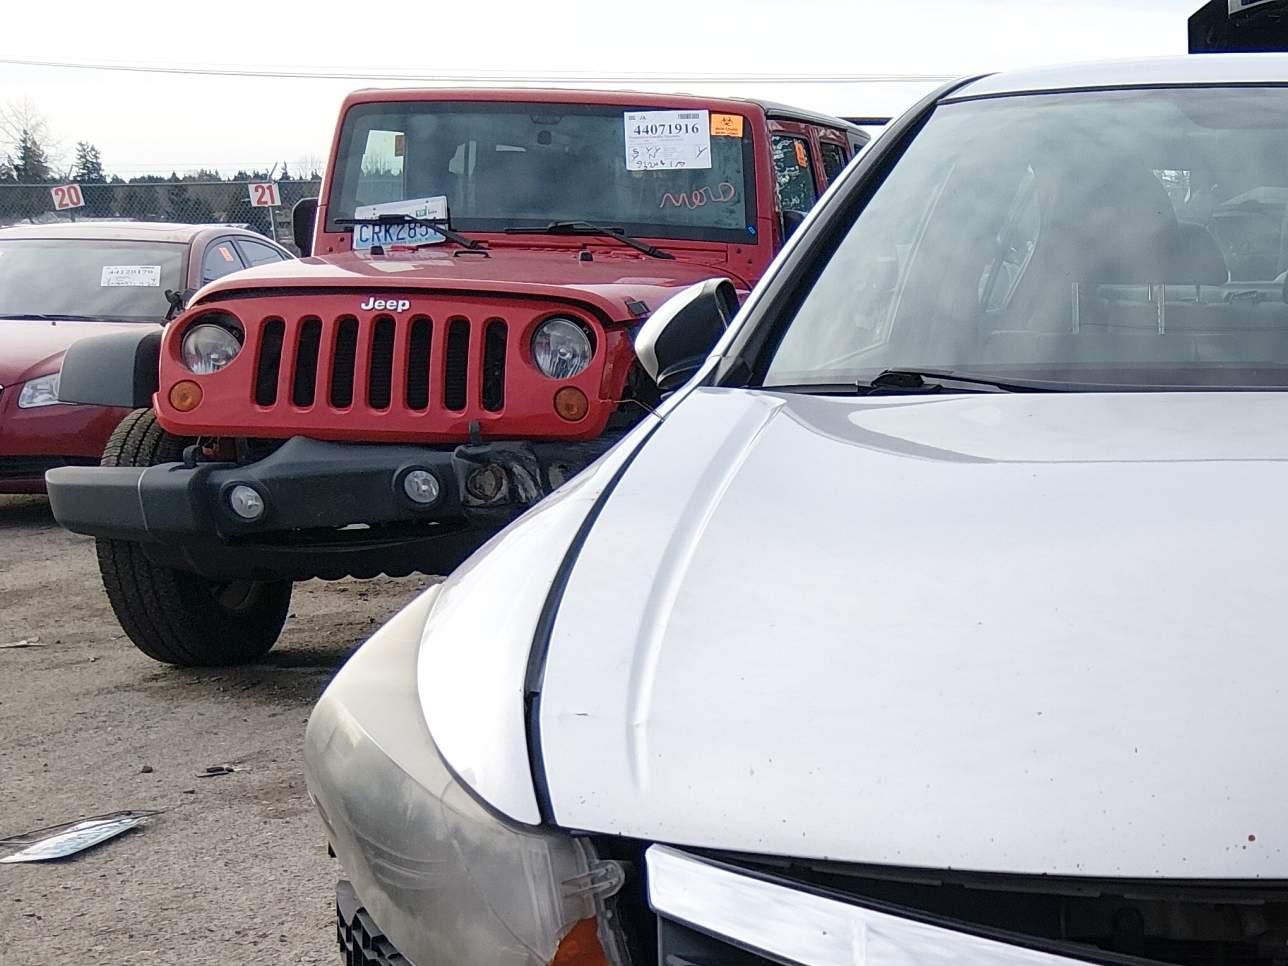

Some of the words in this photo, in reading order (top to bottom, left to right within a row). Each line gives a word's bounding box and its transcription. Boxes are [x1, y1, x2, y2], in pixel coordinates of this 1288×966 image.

[634, 123, 700, 135] 44071916
[54, 185, 81, 209] 20
[255, 185, 276, 205] 21
[360, 296, 410, 313] Jeep
